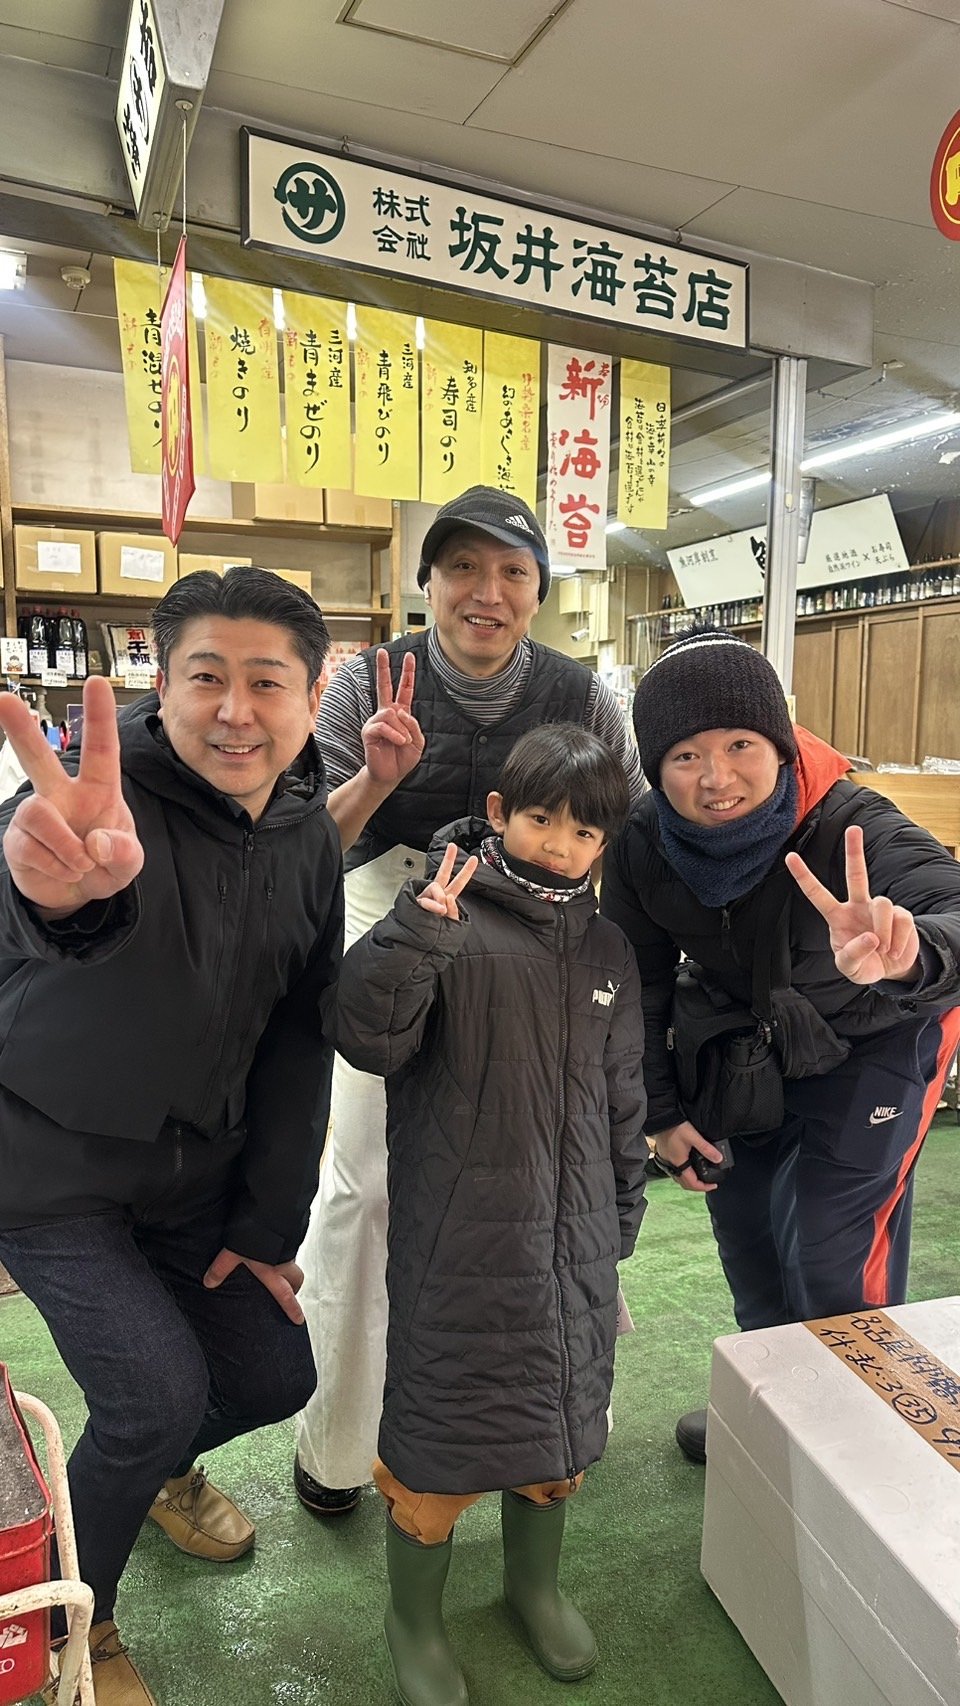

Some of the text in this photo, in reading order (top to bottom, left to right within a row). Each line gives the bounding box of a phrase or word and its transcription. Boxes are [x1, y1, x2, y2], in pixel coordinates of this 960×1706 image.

[372, 186, 432, 227] 株式
[372, 224, 432, 262] 会社
[448, 206, 733, 331] 坂井海苔店
[229, 325, 256, 433] 焼きのり
[328, 329, 343, 388] 三河産
[402, 343, 414, 389] 三河産
[299, 329, 328, 474] 青まぜのり
[375, 349, 393, 466] 青飛びのり
[439, 375, 460, 474] 寿司のり
[558, 357, 604, 549] 新海苔
[505, 518, 534, 535] adidas
[874, 1106, 898, 1117] NIKE
